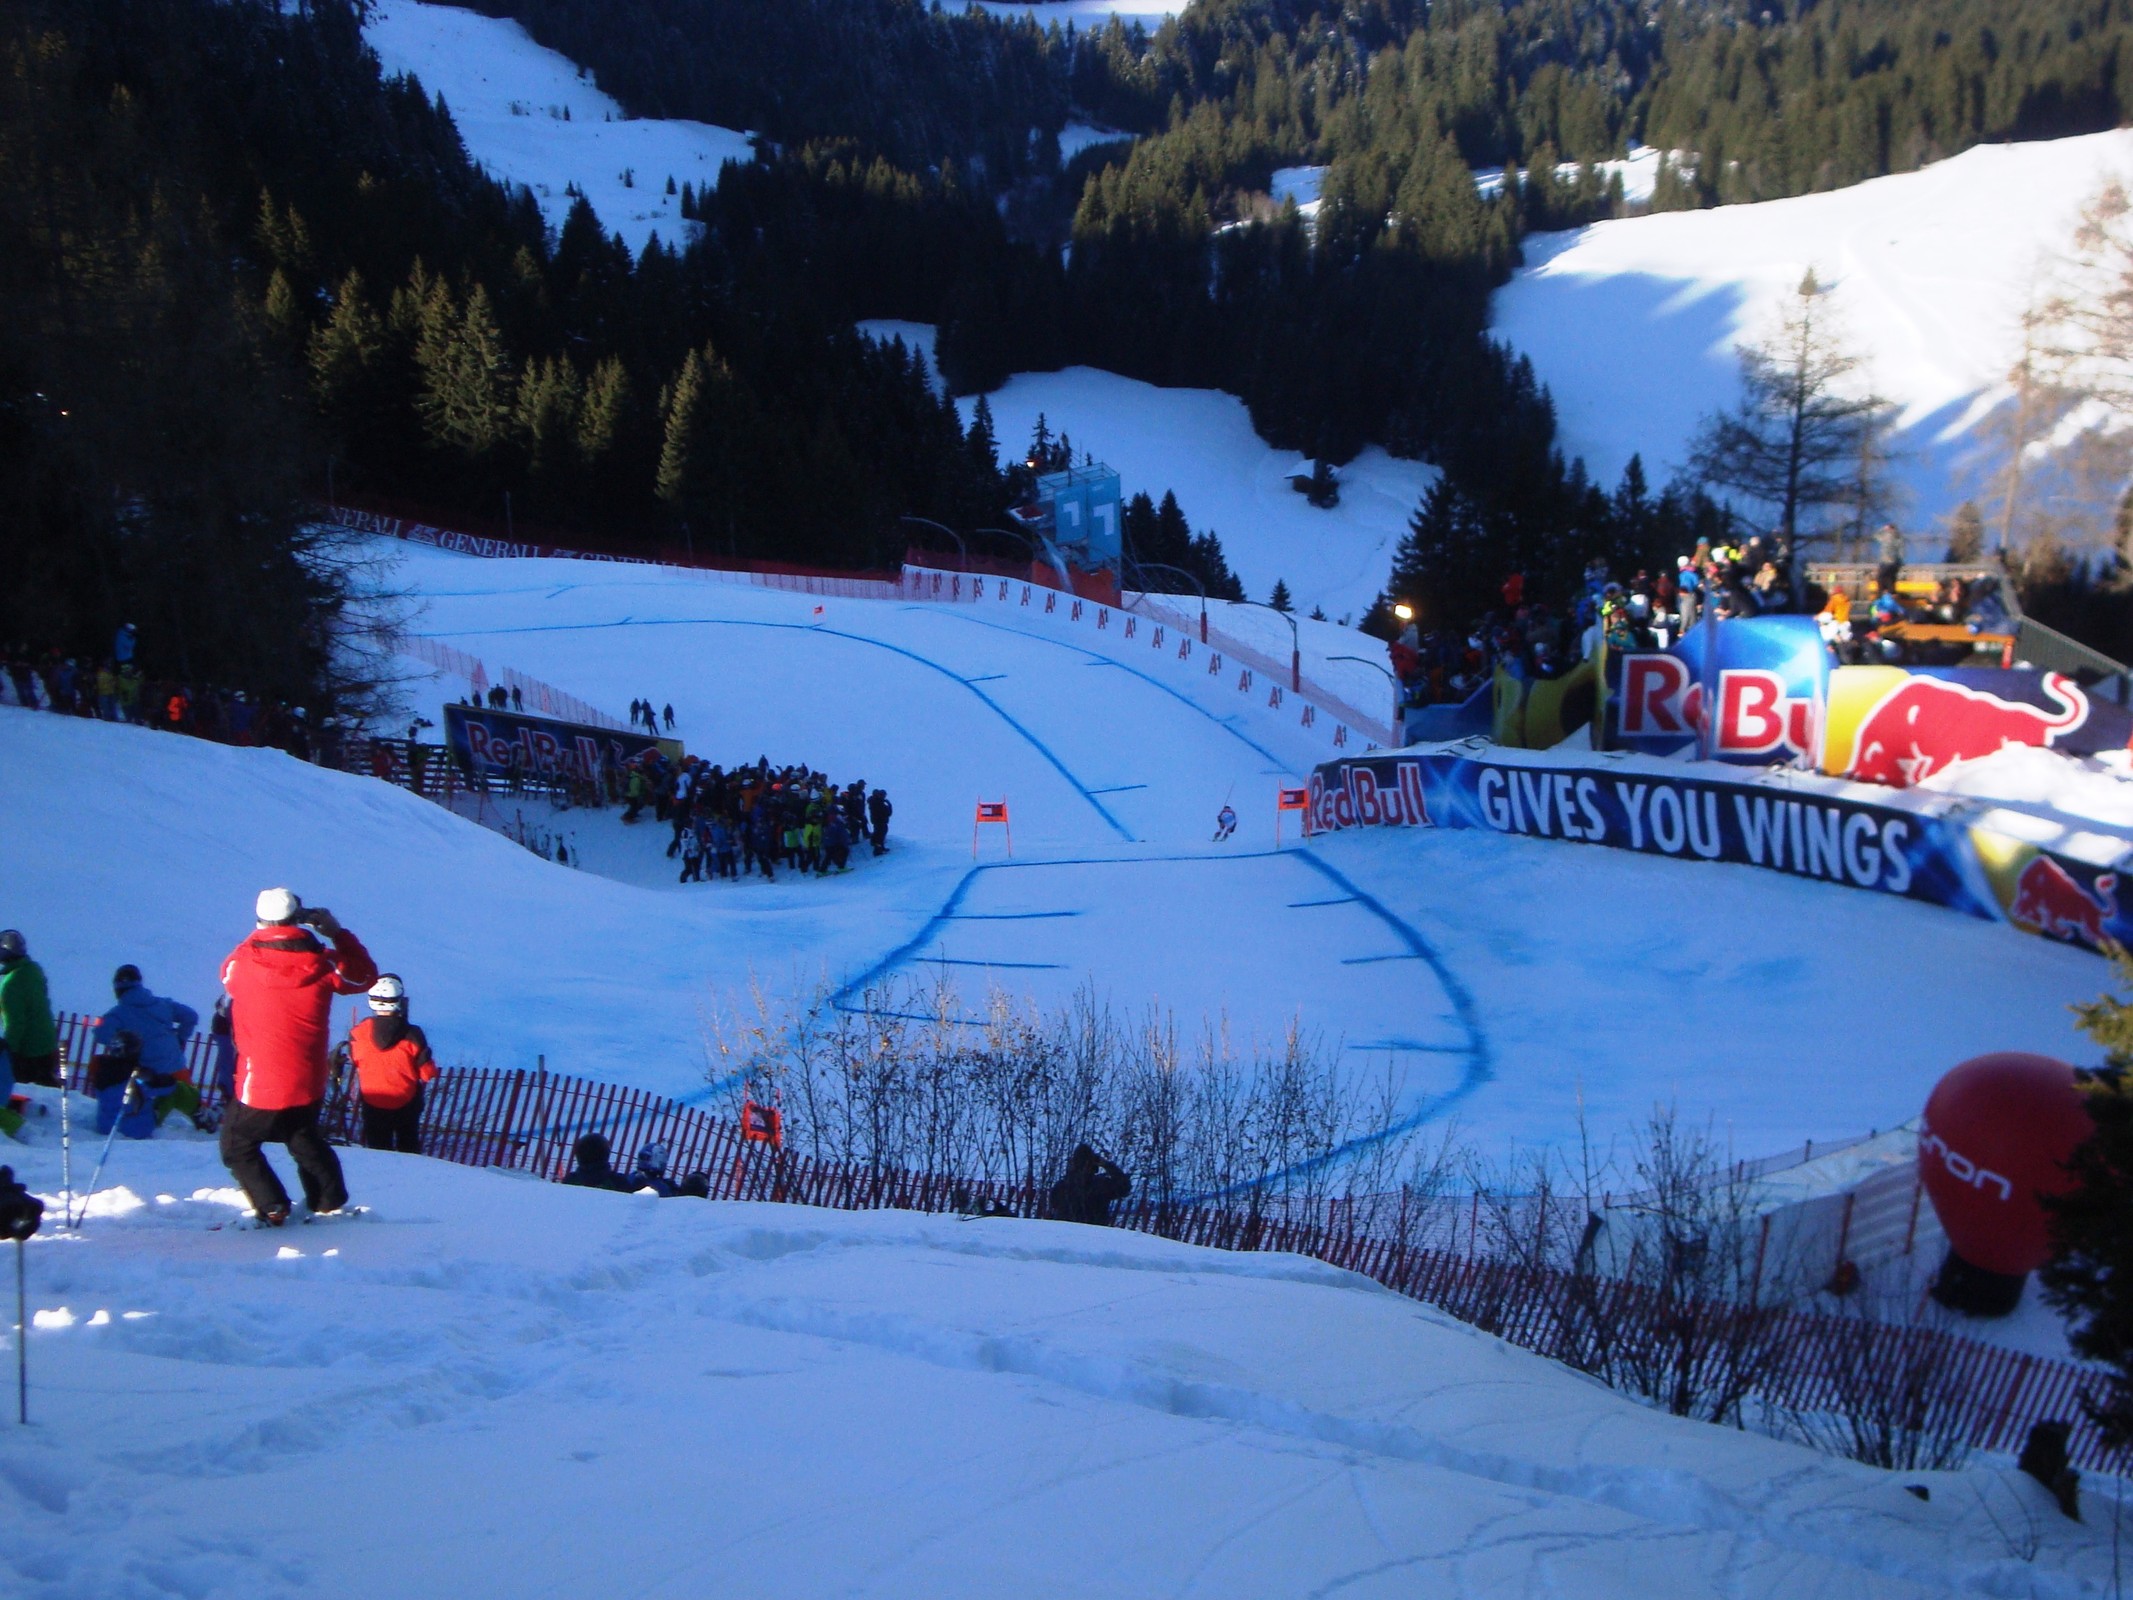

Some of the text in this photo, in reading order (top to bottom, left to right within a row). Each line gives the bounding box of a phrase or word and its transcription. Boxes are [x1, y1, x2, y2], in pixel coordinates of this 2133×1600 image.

[329, 505, 403, 538] NERALI
[1063, 501, 1080, 527] 1
[1093, 503, 1115, 536] 1
[439, 530, 541, 558] GENERALI
[1309, 762, 1911, 893] Red Bull GIVES YOU WINGS
